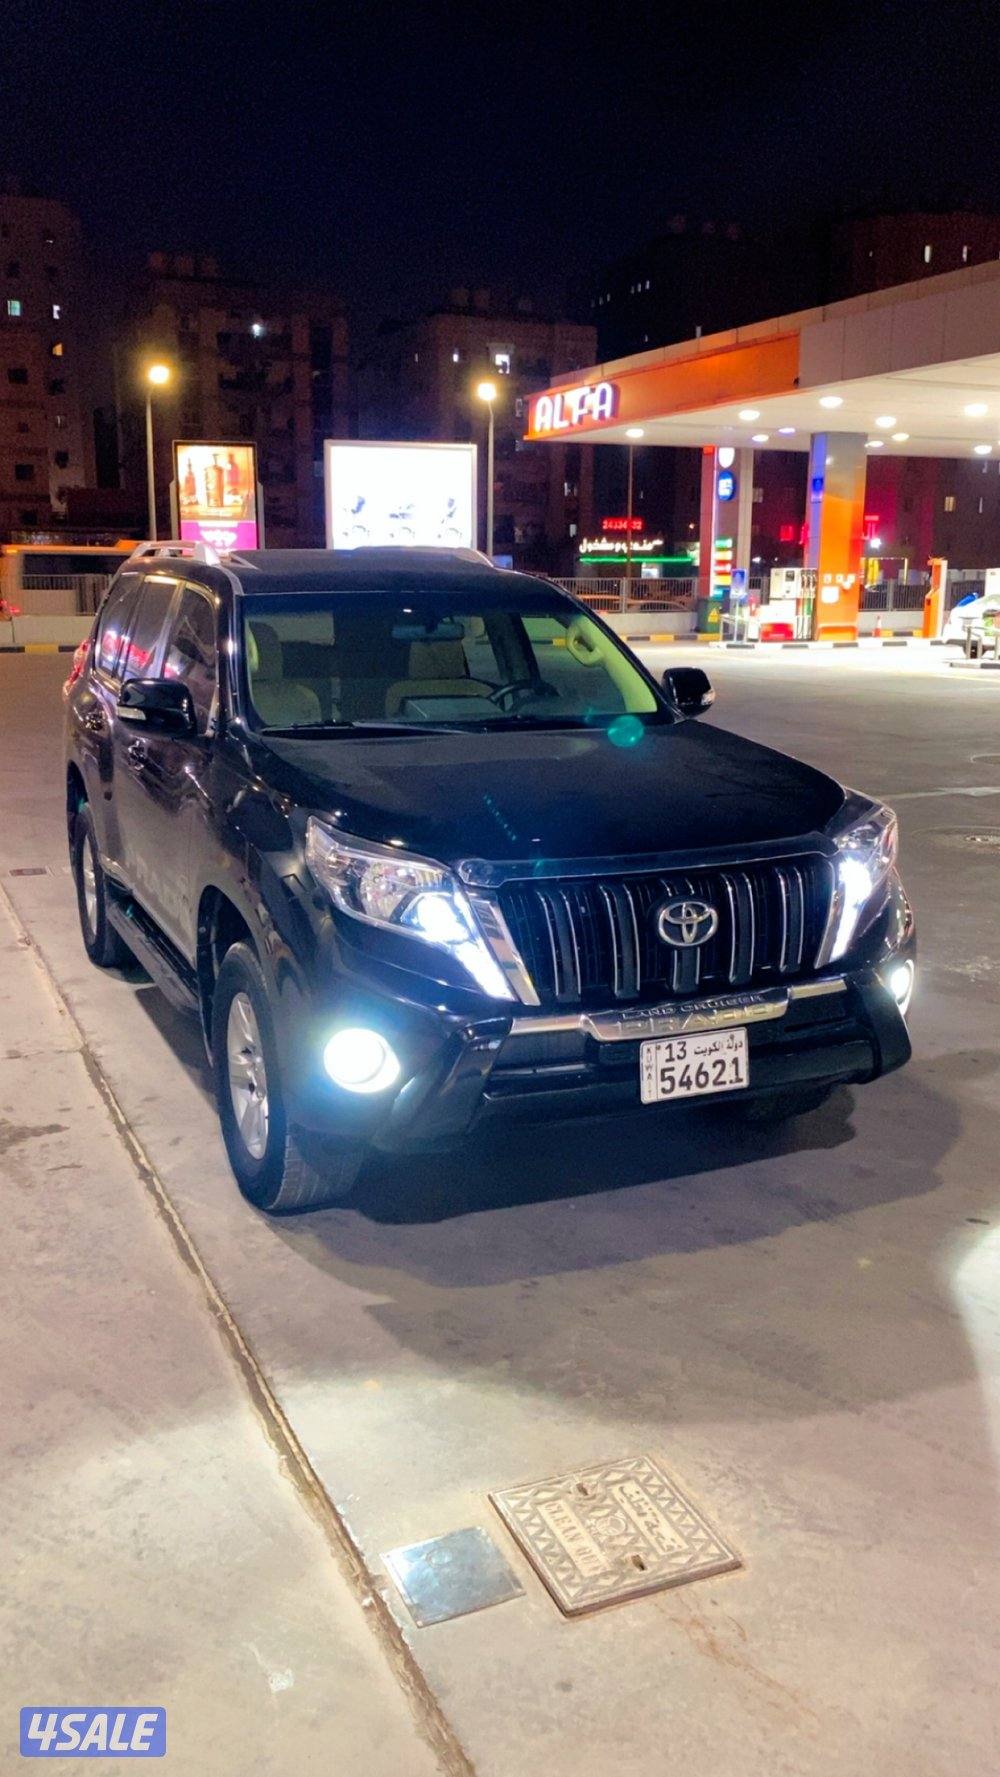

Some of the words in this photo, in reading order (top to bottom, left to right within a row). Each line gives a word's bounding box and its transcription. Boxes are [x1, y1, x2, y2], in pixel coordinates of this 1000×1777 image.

[534, 382, 613, 433] ALFA
[617, 1003, 777, 1034] PRADO
[622, 1006, 675, 1020] LAND
[680, 994, 765, 1013] CRUISER
[665, 1041, 687, 1062] 13
[694, 1041, 723, 1057] الكويت
[726, 1034, 743, 1051] دولة
[660, 1056, 744, 1095] 54621
